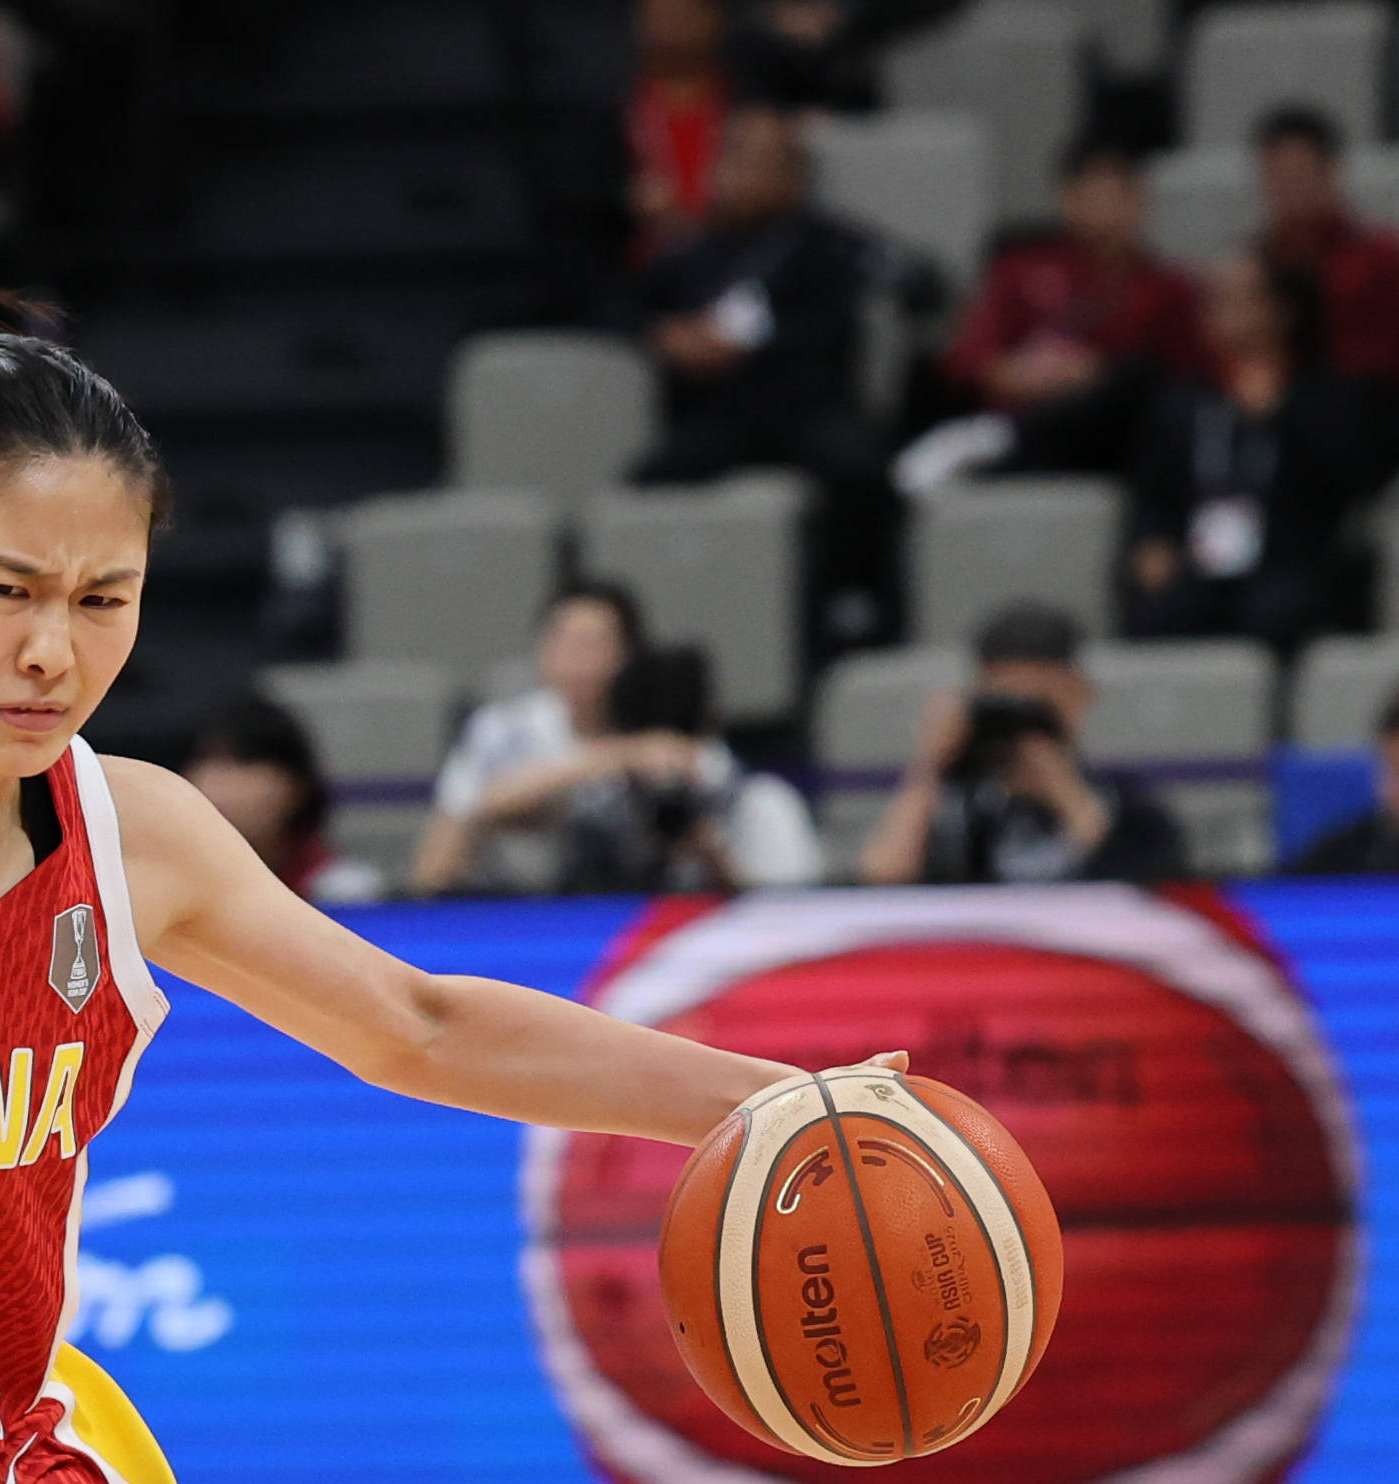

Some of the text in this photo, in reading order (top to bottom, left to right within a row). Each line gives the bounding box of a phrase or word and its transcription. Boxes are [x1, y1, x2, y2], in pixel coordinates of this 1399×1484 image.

[924, 1232, 950, 1268] CUP
[936, 1268, 962, 1311] ASIA
[797, 1244, 862, 1407] molten
